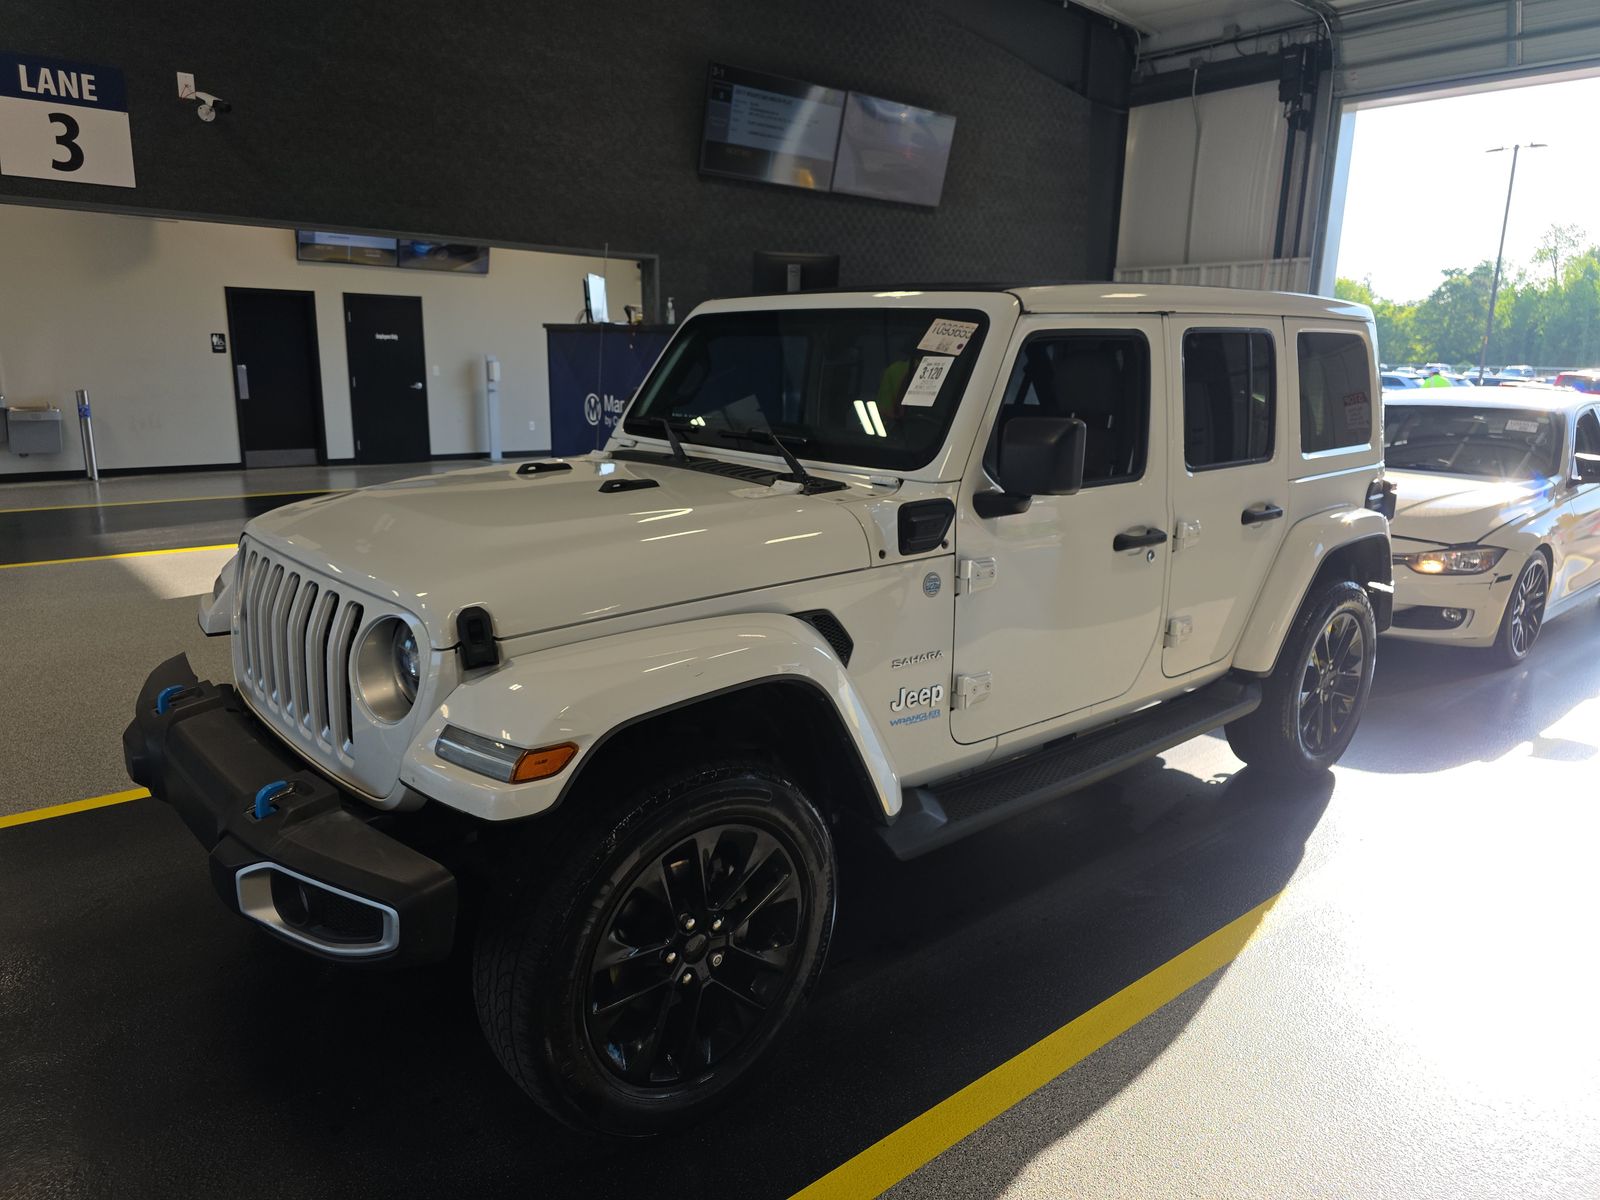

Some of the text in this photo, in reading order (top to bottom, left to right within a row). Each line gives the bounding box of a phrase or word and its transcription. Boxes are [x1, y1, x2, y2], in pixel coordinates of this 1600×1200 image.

[18, 63, 98, 101] LANE
[48, 112, 85, 172] 3
[919, 366, 943, 380] 3:120
[891, 650, 944, 669] SAHARA
[890, 683, 944, 712] Jeep
[889, 709, 941, 727] WRANGLER
